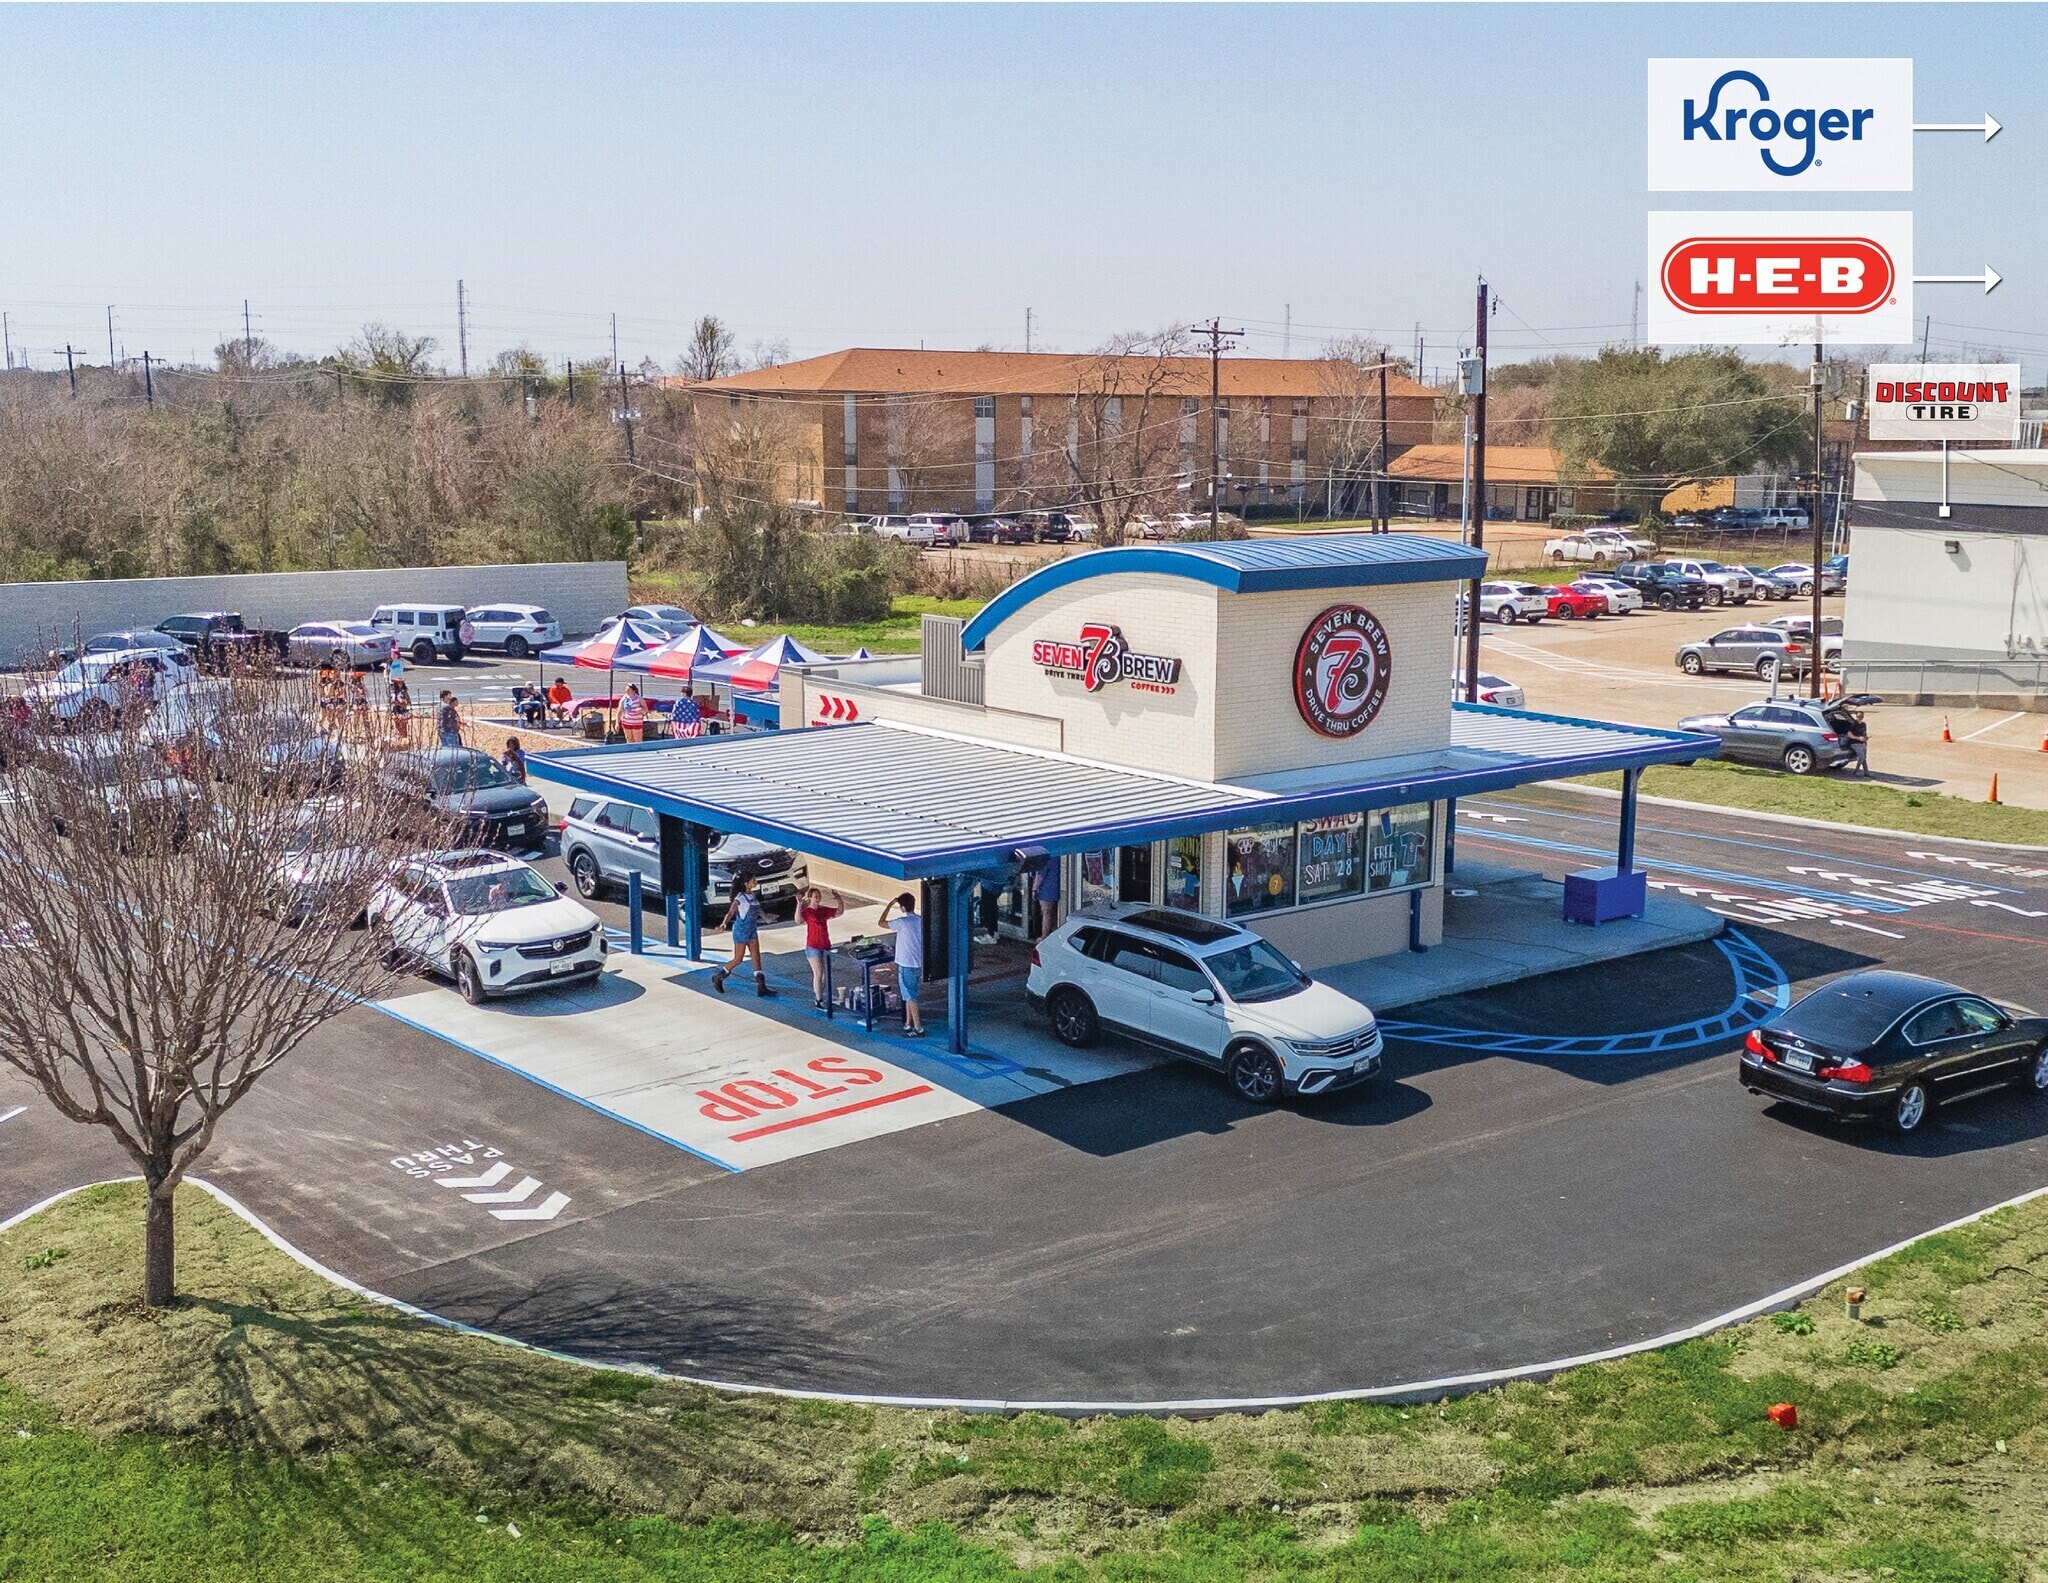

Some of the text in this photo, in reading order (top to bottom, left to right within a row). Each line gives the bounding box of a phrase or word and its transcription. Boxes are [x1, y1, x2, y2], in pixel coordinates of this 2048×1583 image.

[1310, 612, 1387, 655] SEVEN BREW
[1033, 641, 1083, 669] SEVEN
[1123, 655, 1174, 683] BREW
[1045, 669, 1085, 681] DRIVE THRU
[1131, 682, 1160, 693] COFFEE
[1306, 688, 1383, 731] DRIVE THRU COFFEE
[1313, 832, 1353, 857] DAY!
[1374, 844, 1395, 861] FREE
[695, 1057, 883, 1121] STOP
[390, 1139, 484, 1169] THRU
[406, 1147, 504, 1178] PASS
